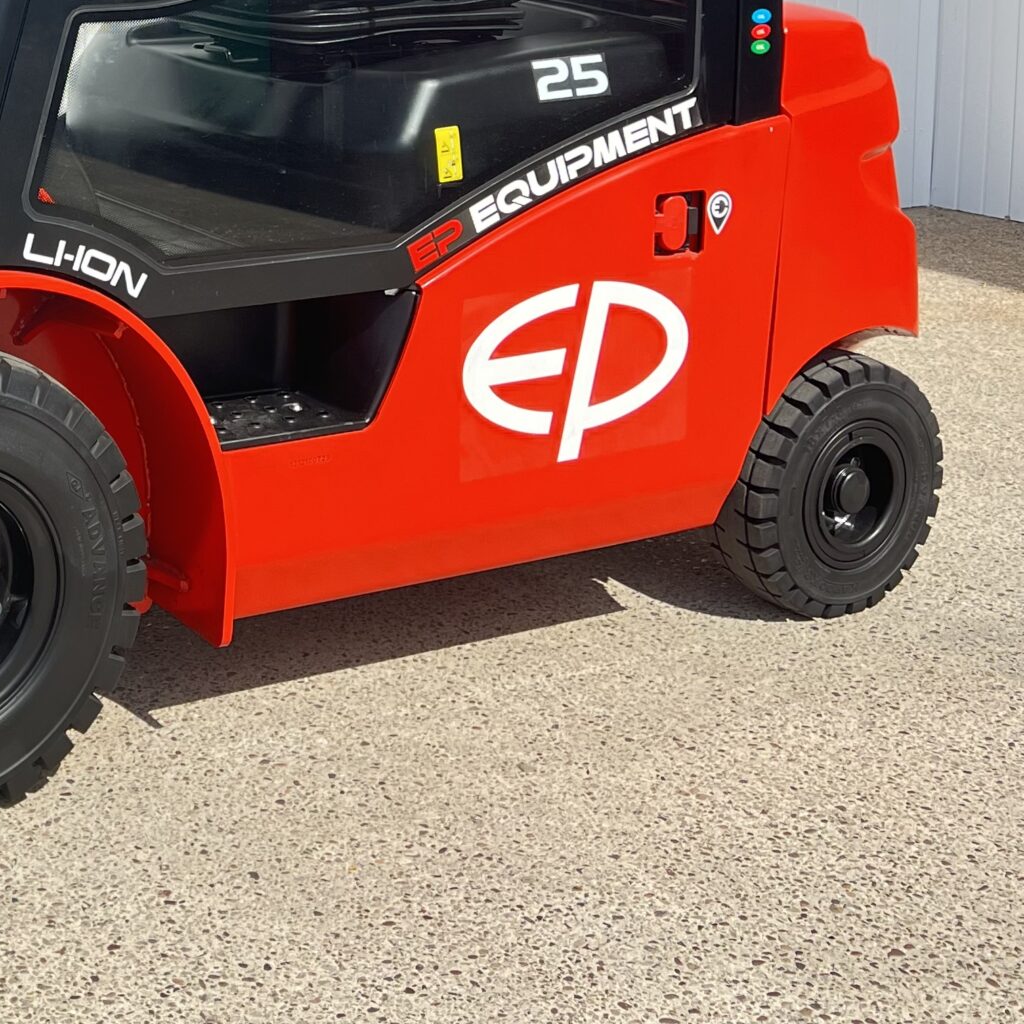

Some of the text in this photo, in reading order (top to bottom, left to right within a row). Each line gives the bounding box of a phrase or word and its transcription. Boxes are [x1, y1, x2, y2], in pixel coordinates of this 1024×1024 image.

[530, 53, 609, 102] 25
[406, 97, 697, 273] EP EQUIPMENT
[462, 280, 689, 463] EP
